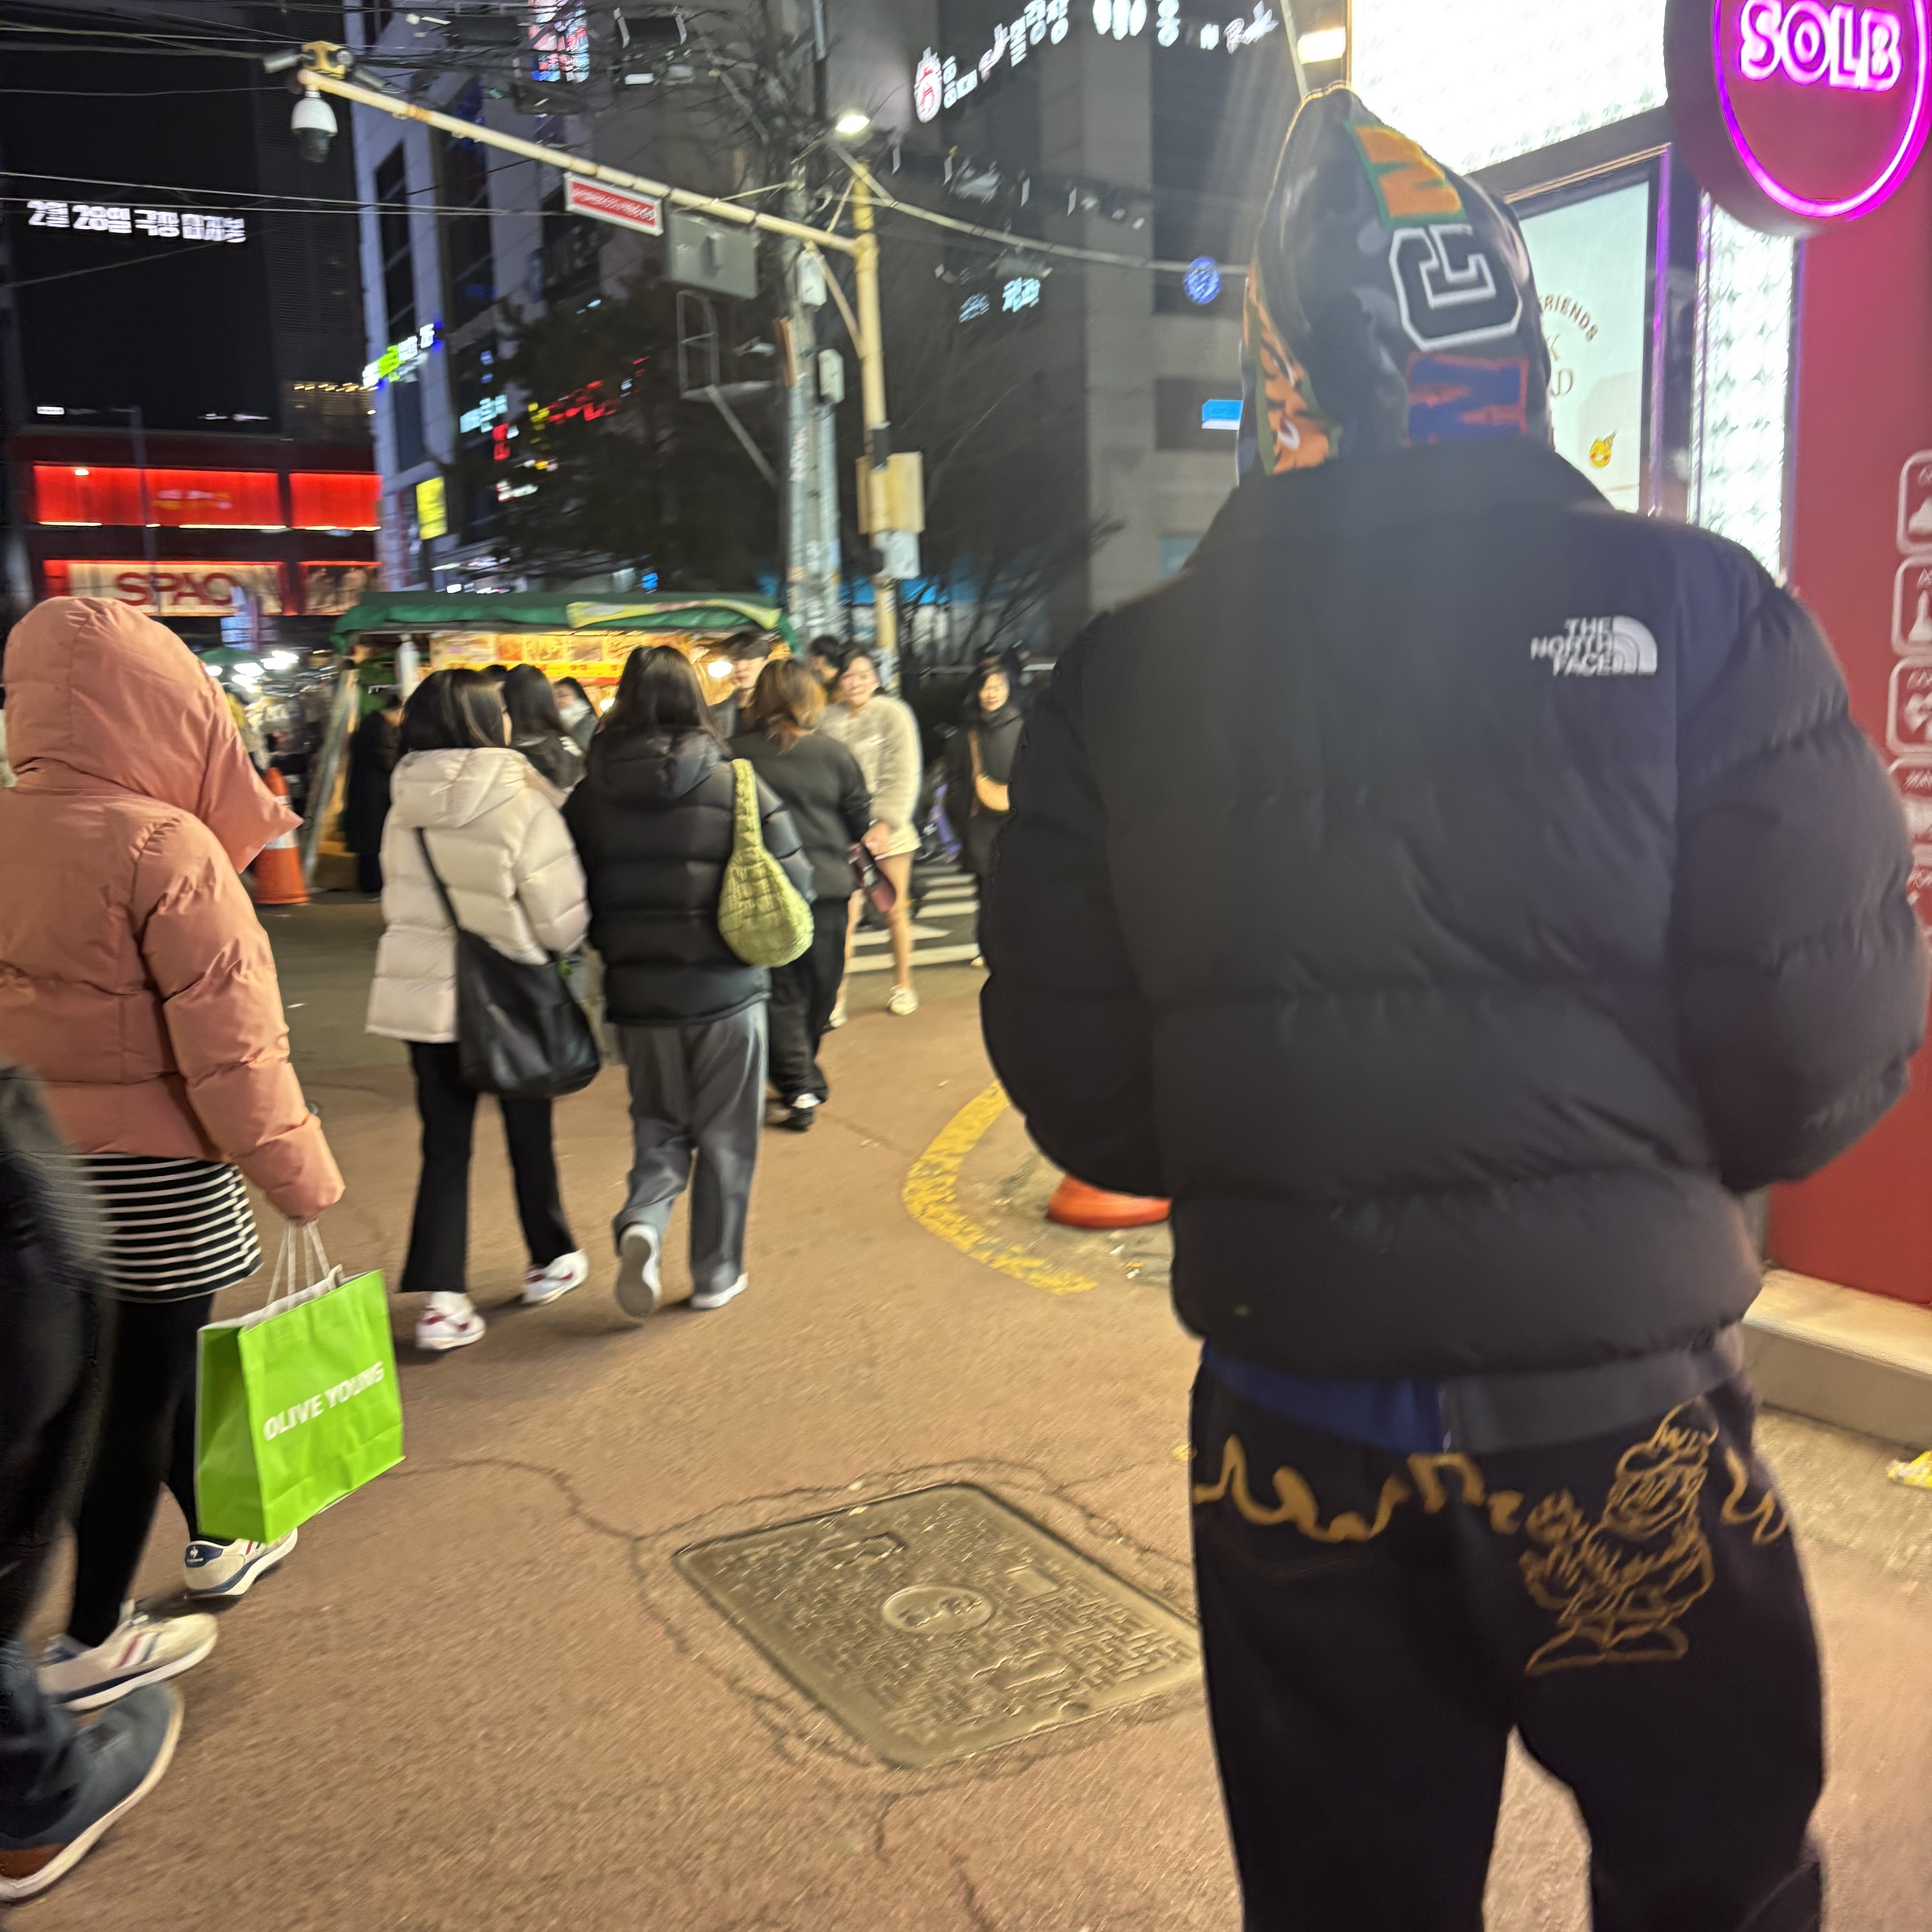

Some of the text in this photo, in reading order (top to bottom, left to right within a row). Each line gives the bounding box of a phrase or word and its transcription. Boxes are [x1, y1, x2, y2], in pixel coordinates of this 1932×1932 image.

[1740, 0, 1904, 92] SOLB
[1539, 293, 1598, 342] RIENDS
[115, 571, 236, 606] SPAO
[1564, 617, 1611, 634] THE
[262, 1394, 323, 1441] OLIVE
